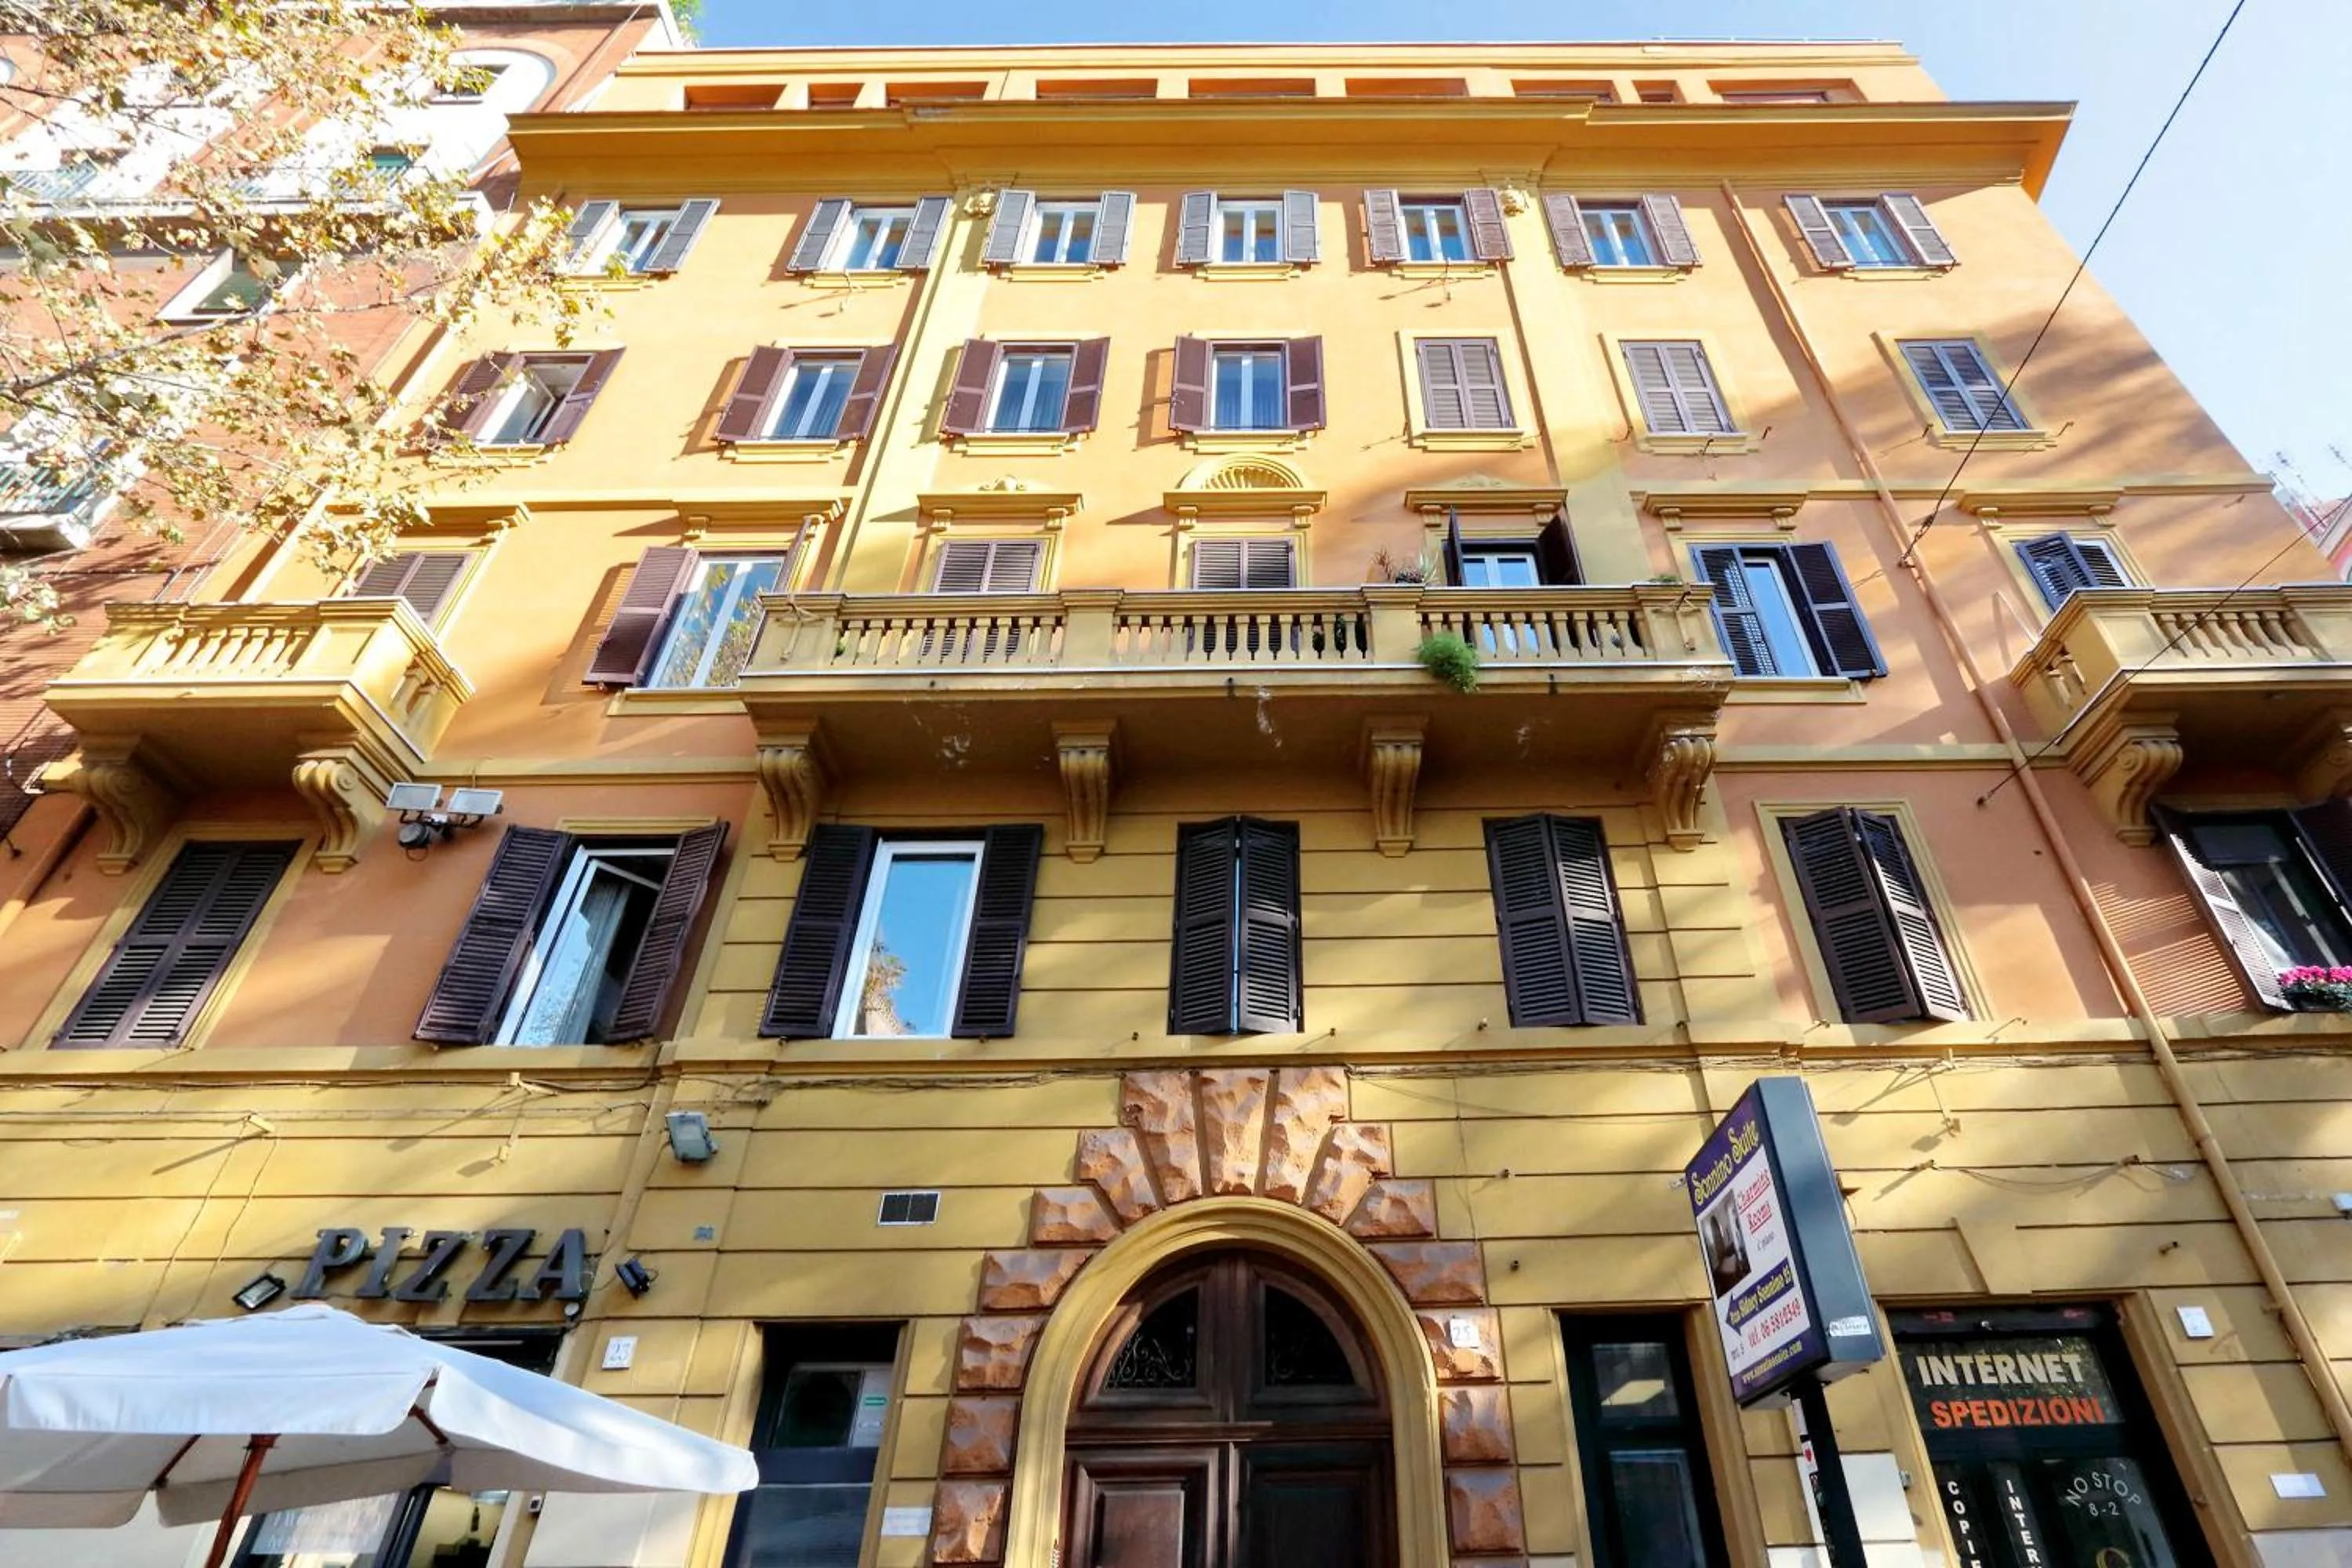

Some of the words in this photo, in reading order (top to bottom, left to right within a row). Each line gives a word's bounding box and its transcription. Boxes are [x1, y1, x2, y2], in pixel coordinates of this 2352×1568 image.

[1691, 1153, 1733, 1206] Sonnino
[291, 1227, 587, 1301] PIZZA
[1915, 1353, 2085, 1387] INTERNET
[1930, 1395, 2107, 1429] SPEDIZIONI
[2065, 1477, 2089, 1507] NO
[2091, 1471, 2142, 1505] STOP
[2006, 1479, 2043, 1568] INTER
